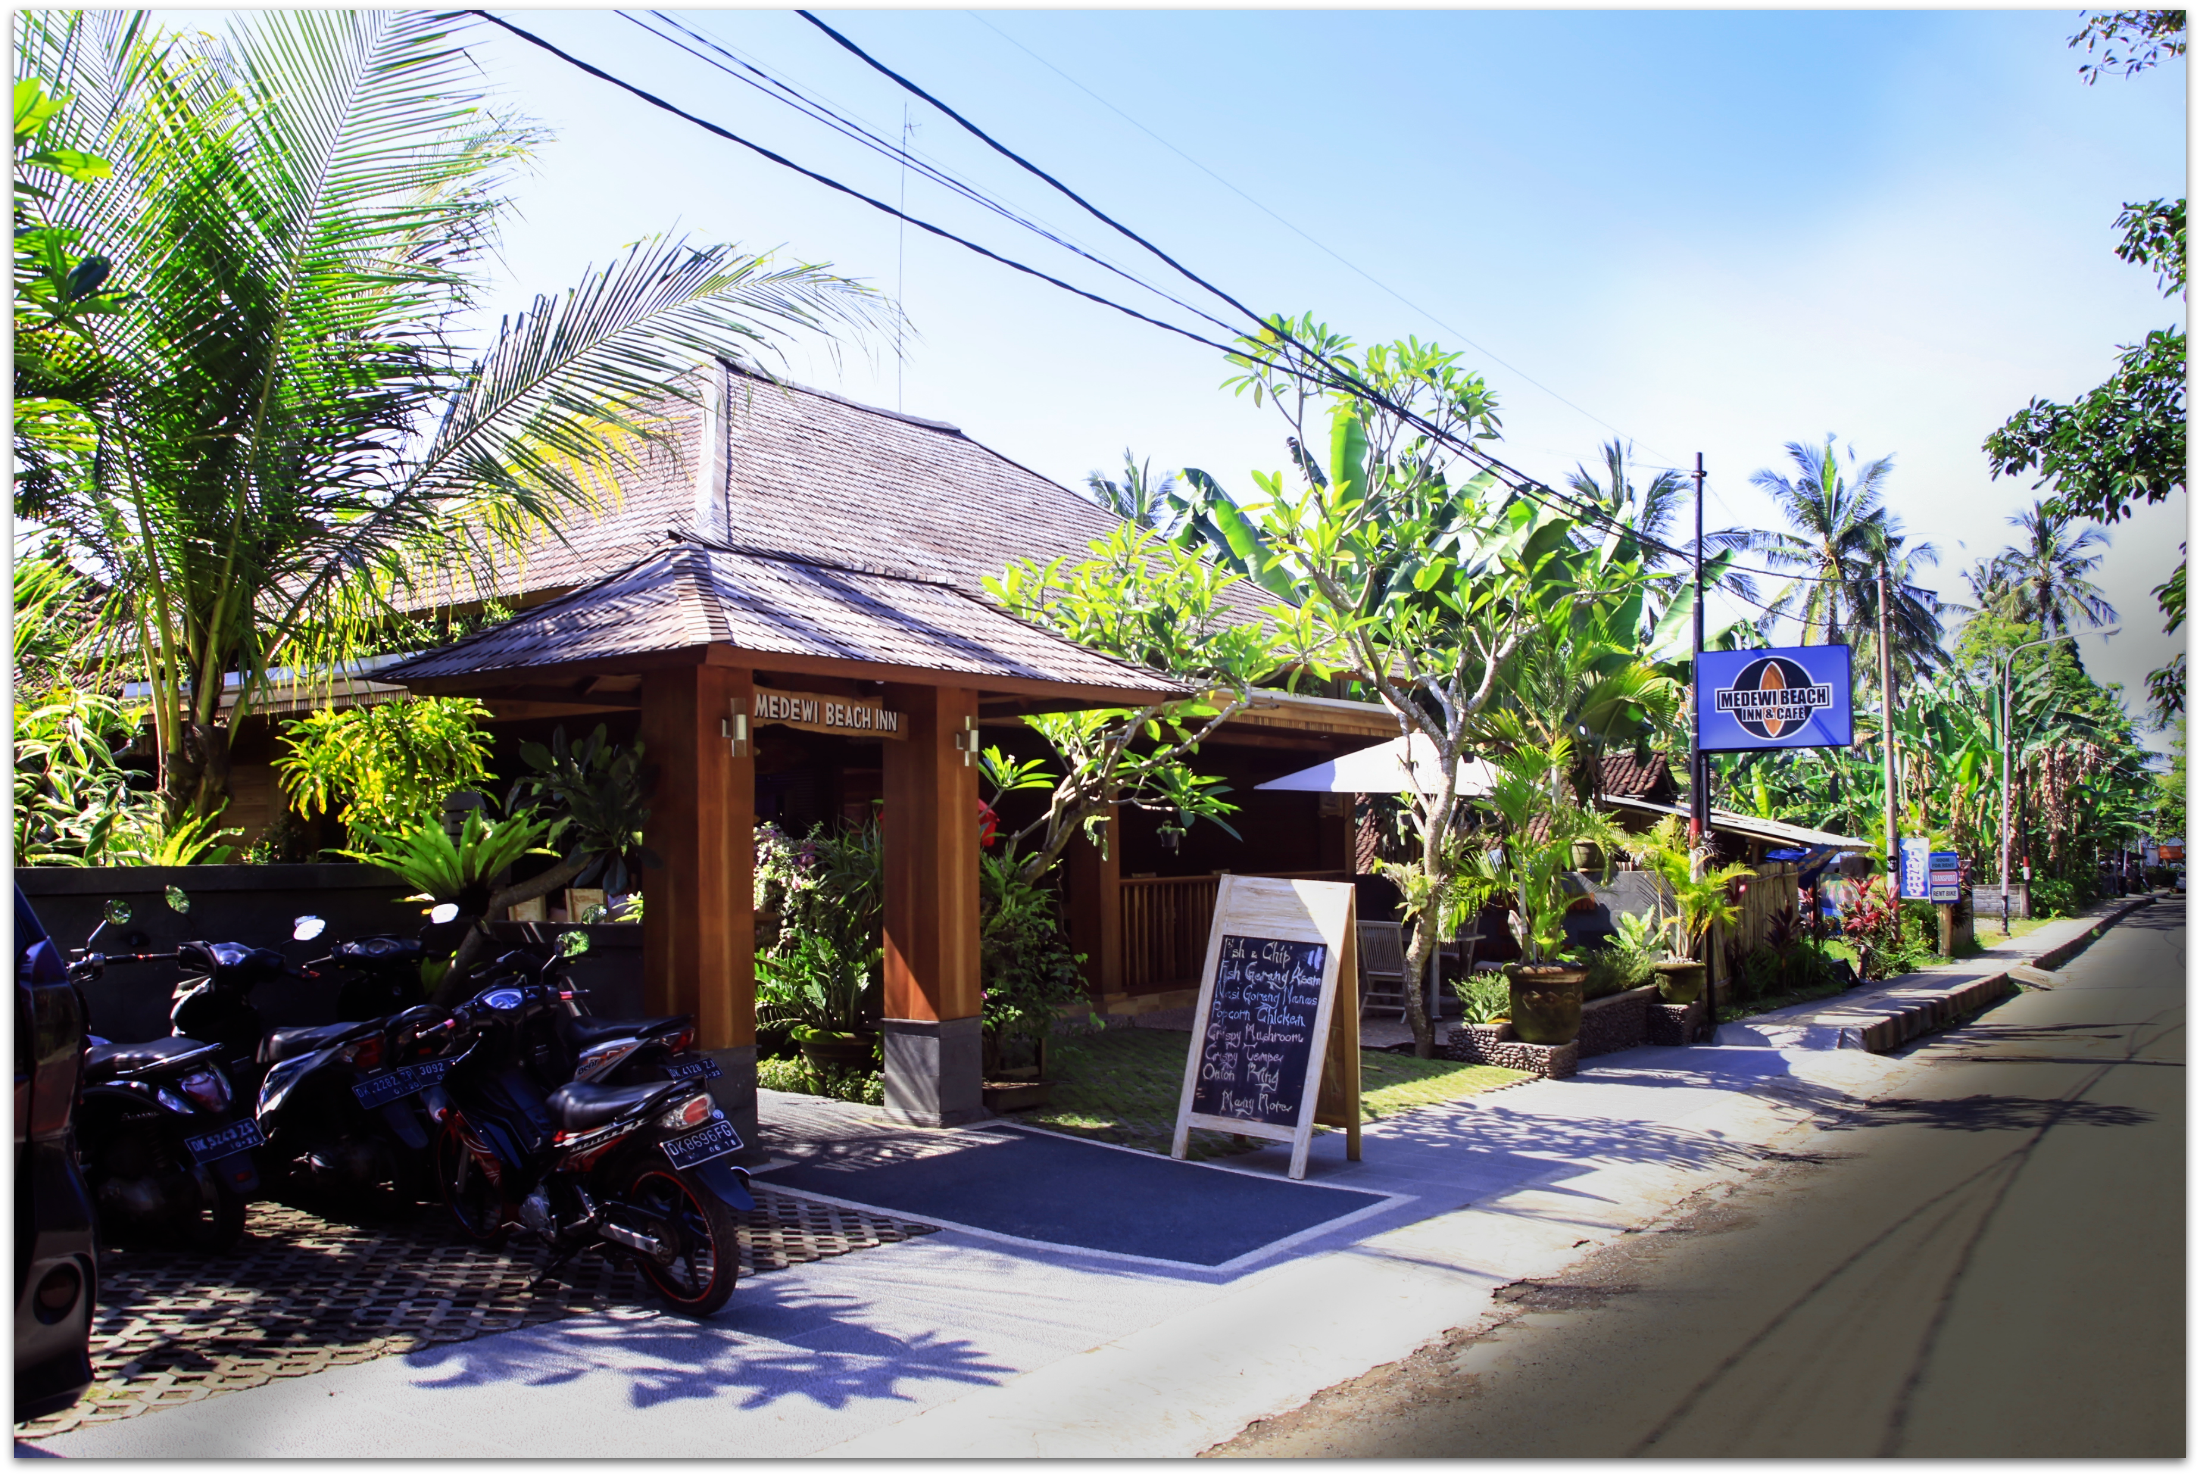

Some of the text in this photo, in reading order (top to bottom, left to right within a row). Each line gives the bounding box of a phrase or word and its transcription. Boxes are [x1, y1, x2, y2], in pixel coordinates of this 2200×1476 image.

[1720, 688, 1827, 708] MEDEWI BEACH
[754, 693, 898, 731] MEDEWI BEACH INN
[1742, 708, 1762, 722] INN
[1766, 709, 1774, 719] &
[1932, 874, 1956, 882] TRANSPORT
[1243, 985, 1280, 1009] Goreng
[1211, 1000, 1306, 1027] Popcorn Chicken
[1207, 1023, 1304, 1049] Crispy Mushroom
[703, 1059, 717, 1070] ZJ
[1205, 1041, 1238, 1069] Crispy
[420, 1062, 445, 1076] 3092
[1203, 1062, 1279, 1092] Onion Ring
[355, 1070, 413, 1098] DK 2282 ZP
[1221, 1089, 1293, 1117] Many More
[190, 1139, 207, 1152] DK
[237, 1122, 254, 1139] ZS
